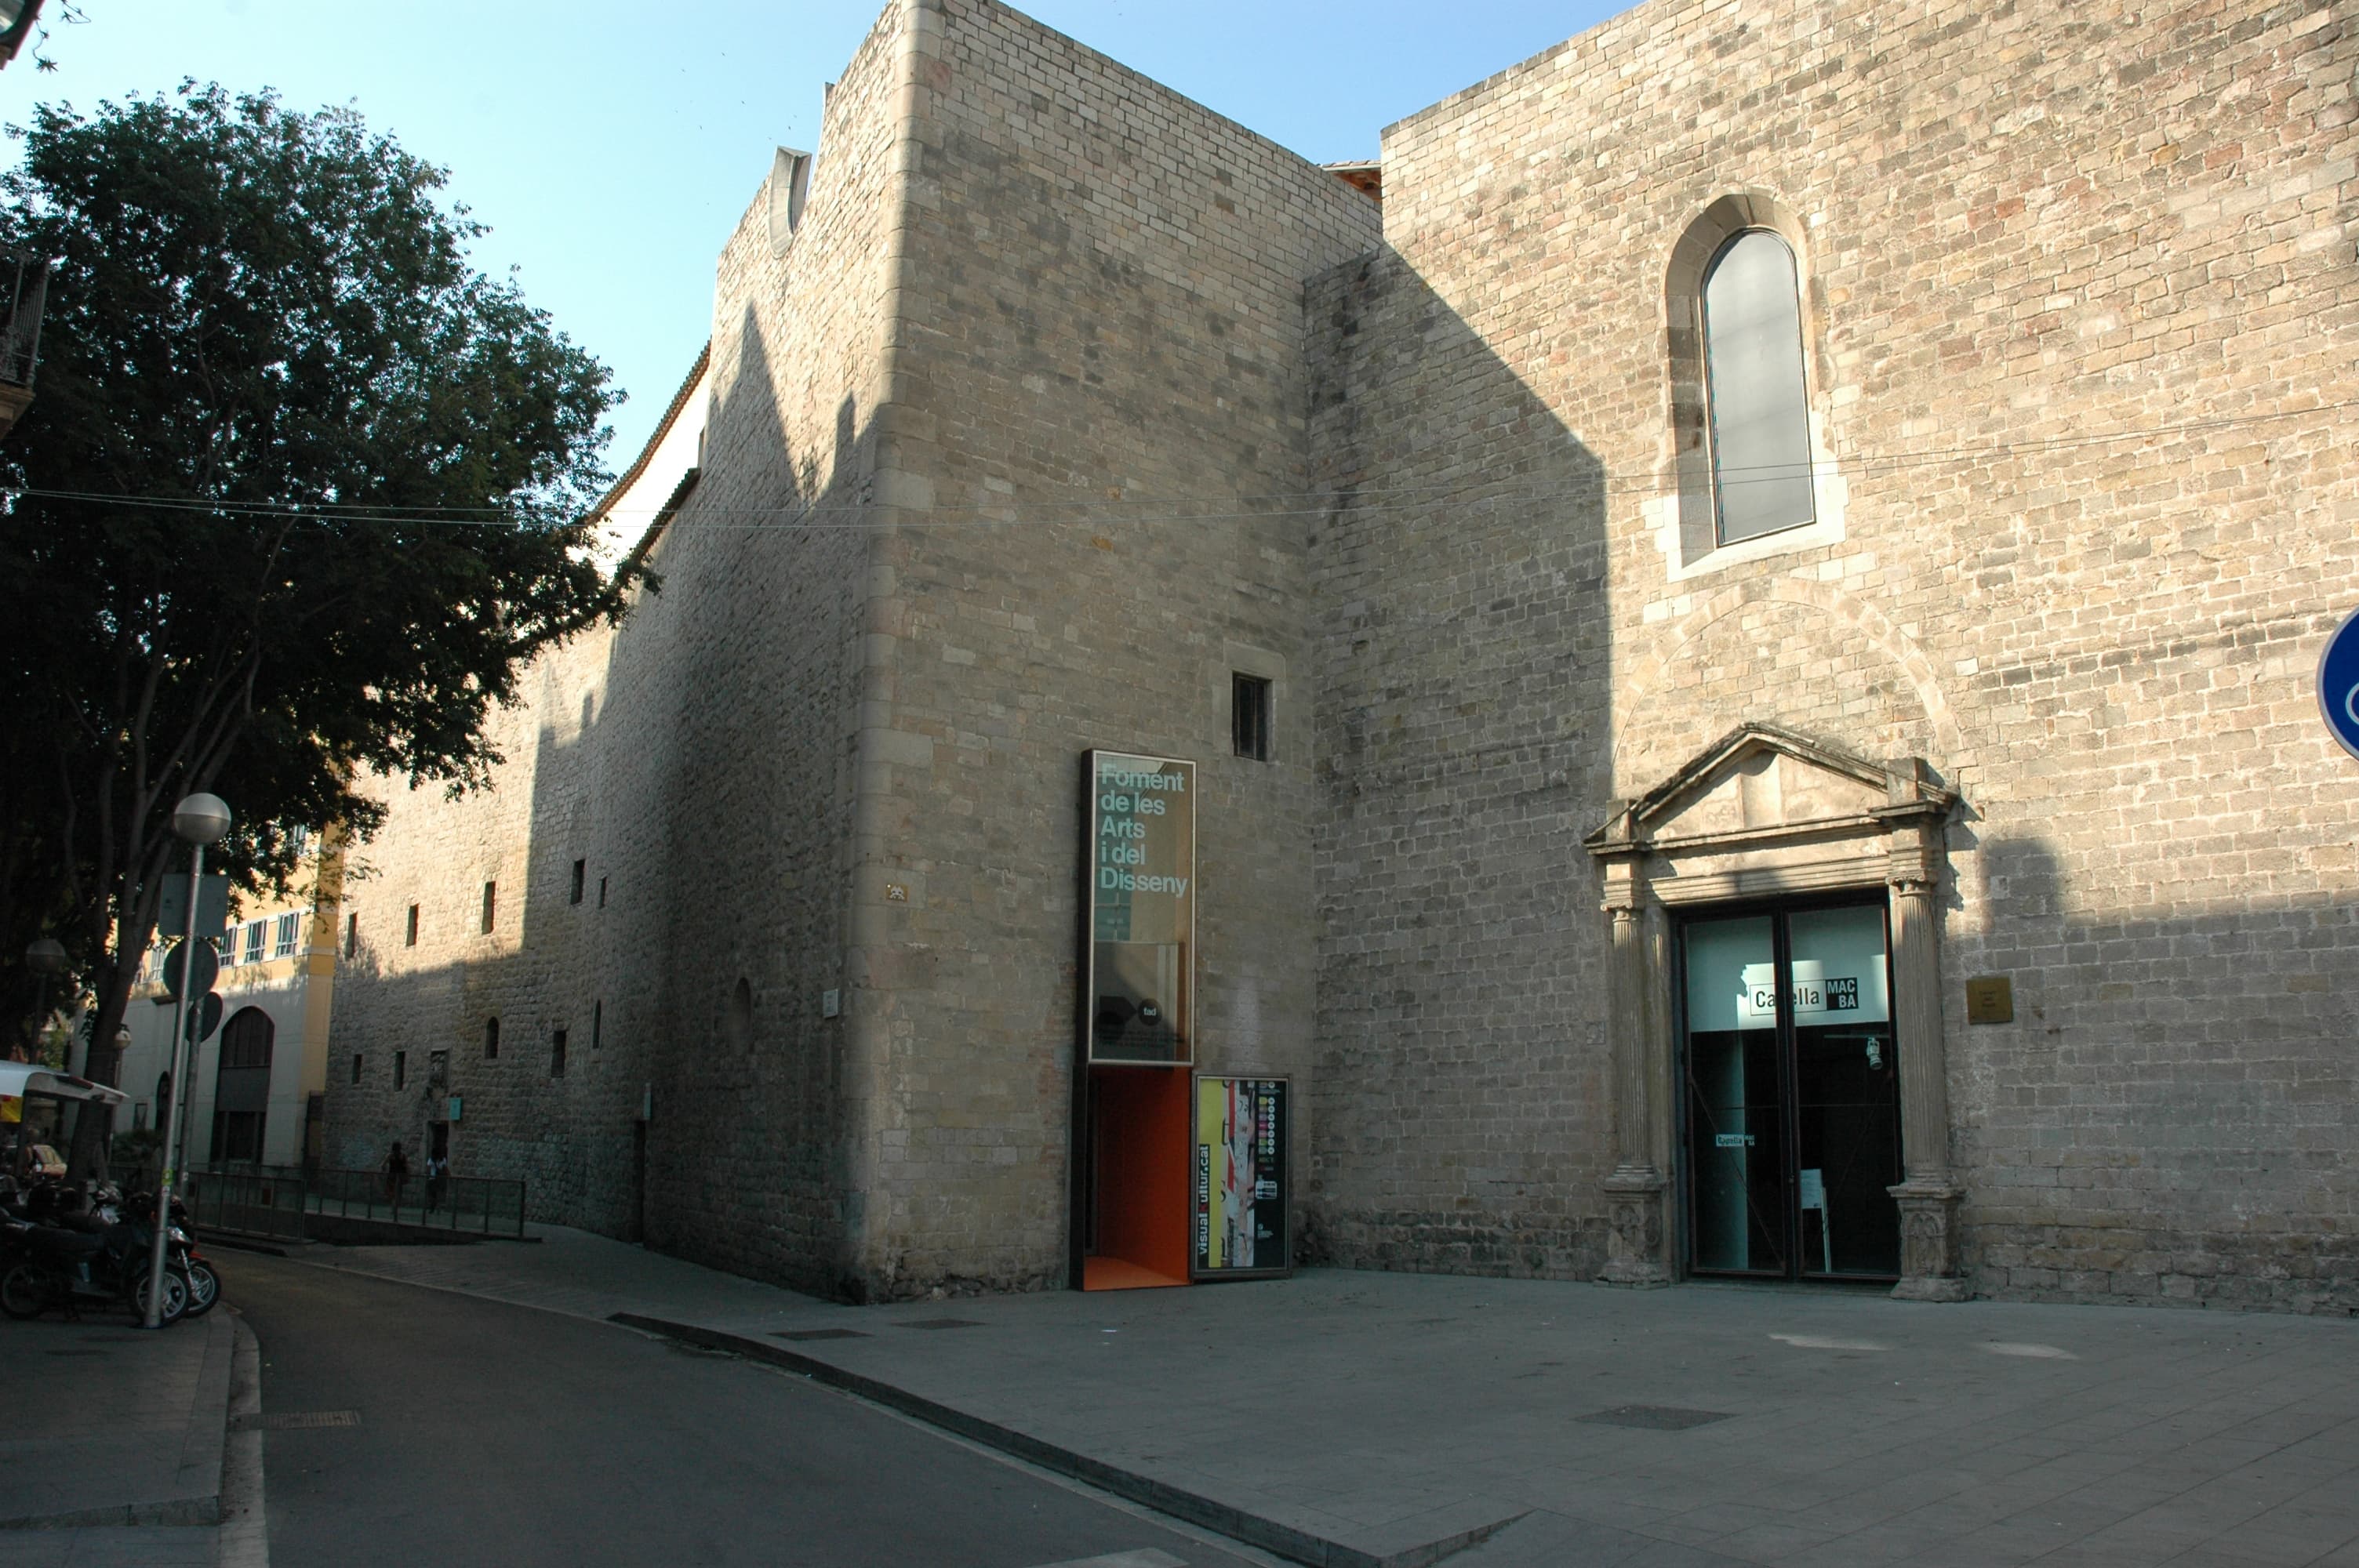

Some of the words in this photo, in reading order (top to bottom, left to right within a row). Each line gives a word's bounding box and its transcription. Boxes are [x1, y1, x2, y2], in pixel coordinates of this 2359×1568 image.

[1101, 763, 1185, 792] Foment
[1100, 789, 1129, 812] de
[1134, 792, 1166, 815] les
[1100, 815, 1146, 839] Arts
[1101, 840, 1107, 862] i
[1111, 841, 1145, 866] del
[1100, 866, 1188, 898] Disseny
[1755, 987, 1819, 1008] Calla
[1826, 979, 1856, 994] MAC
[1143, 1007, 1157, 1016] fad
[1837, 995, 1856, 1008] BA
